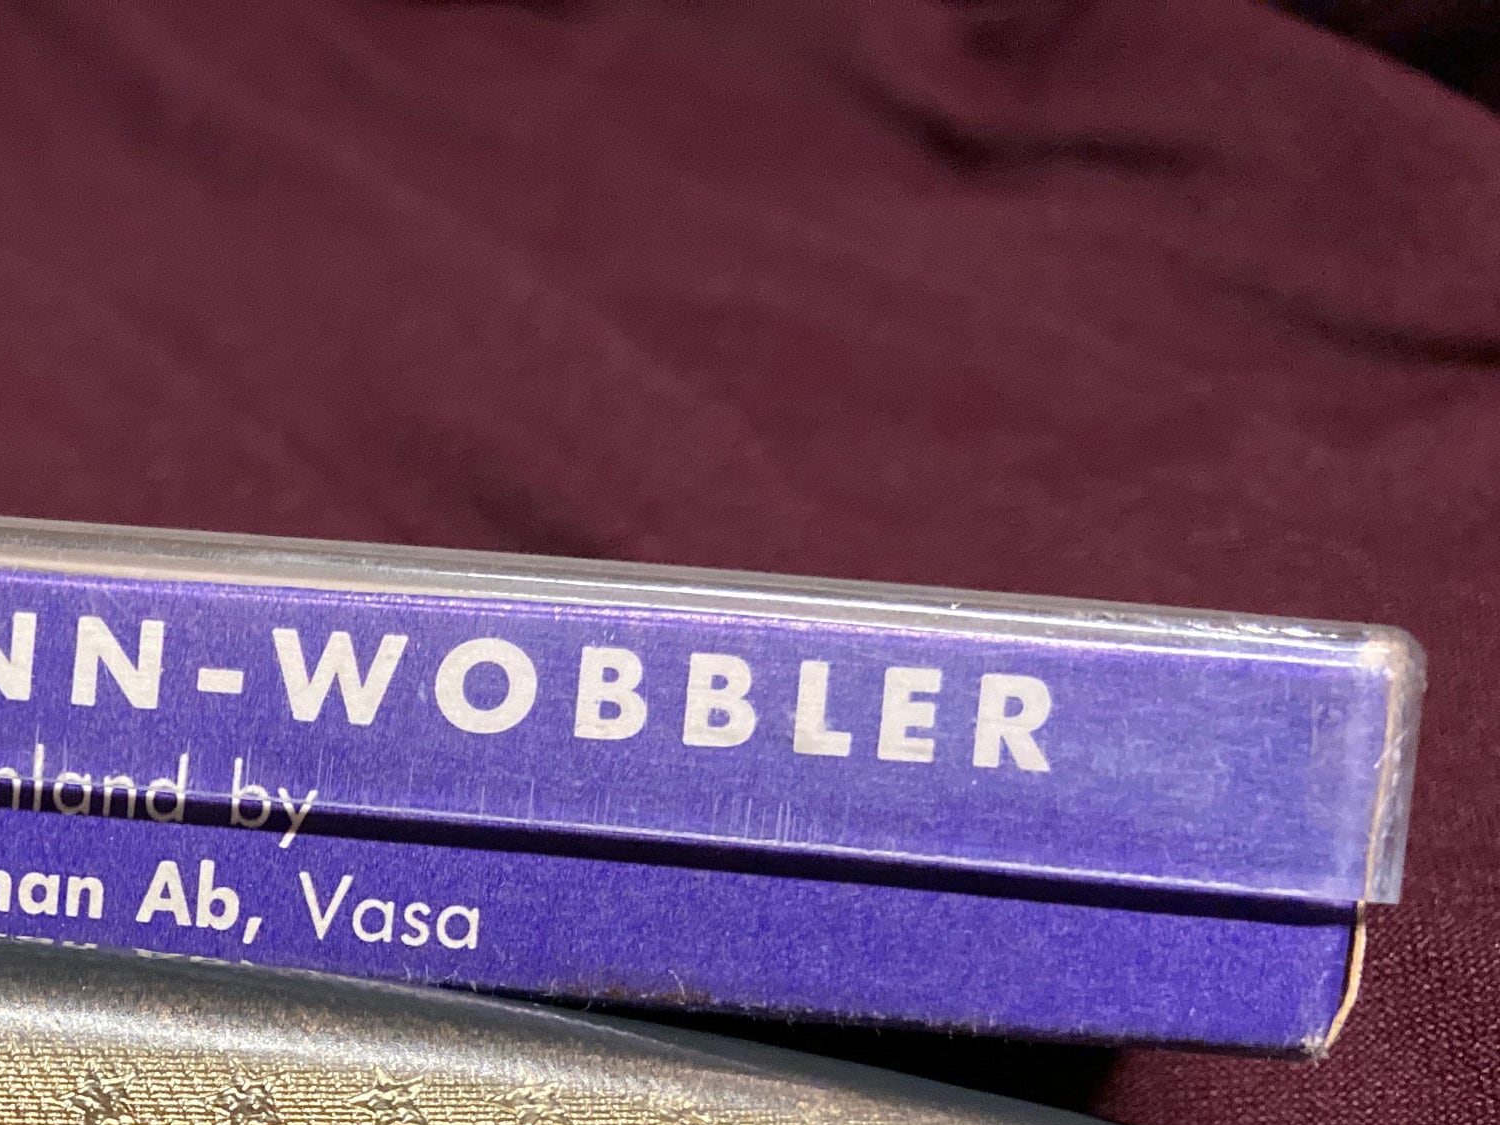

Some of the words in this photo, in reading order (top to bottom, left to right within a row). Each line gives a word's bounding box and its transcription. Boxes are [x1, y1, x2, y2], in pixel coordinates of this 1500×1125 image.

[231, 757, 317, 850] by
[135, 860, 263, 945] Ab,
[301, 870, 481, 951] Vasa
